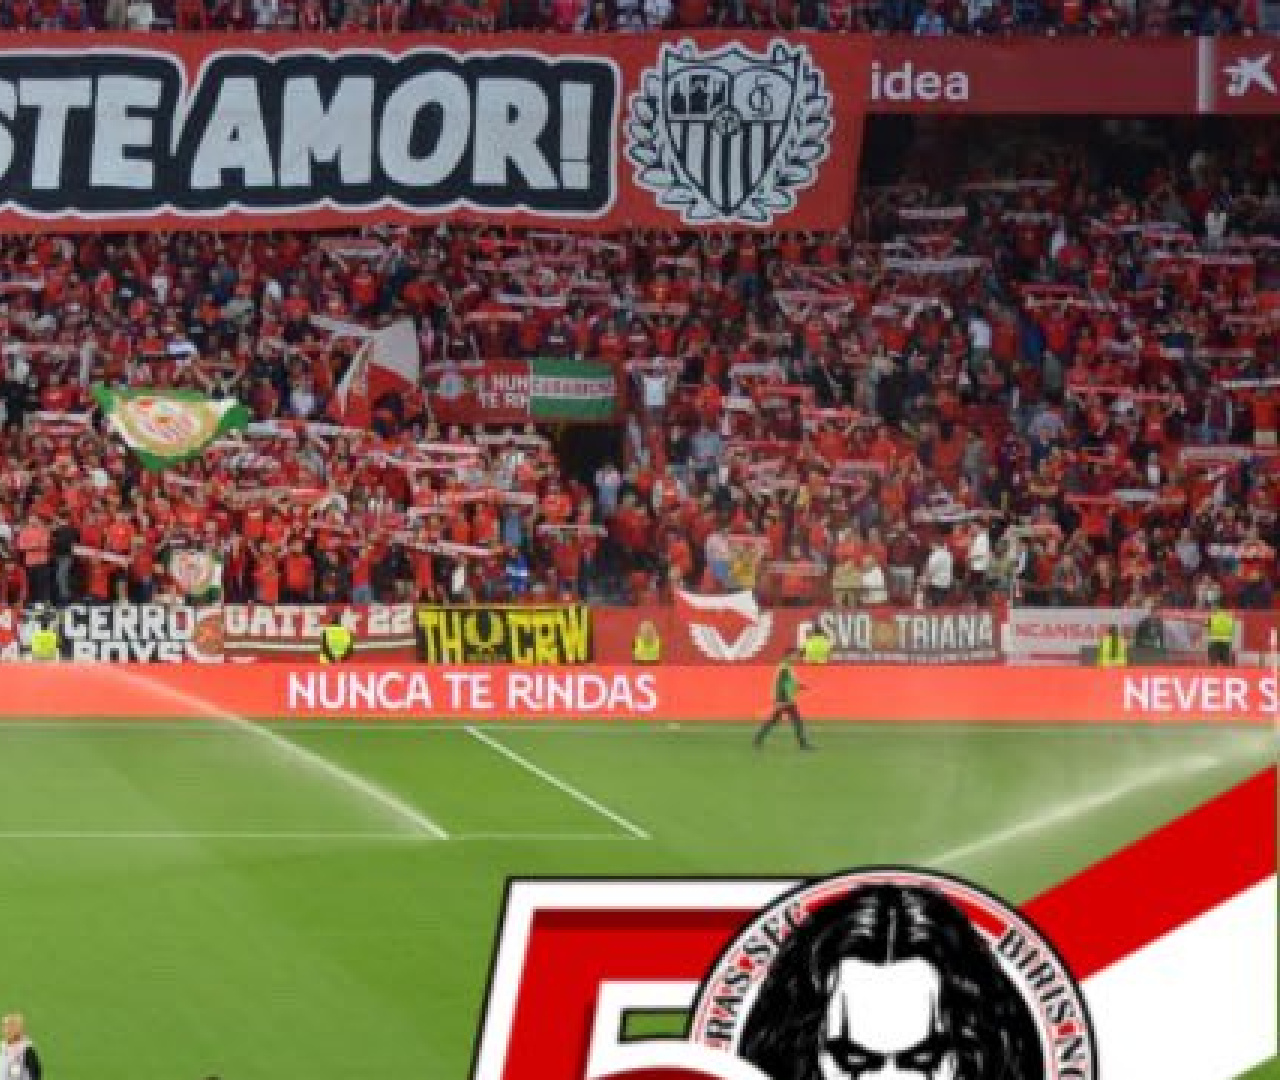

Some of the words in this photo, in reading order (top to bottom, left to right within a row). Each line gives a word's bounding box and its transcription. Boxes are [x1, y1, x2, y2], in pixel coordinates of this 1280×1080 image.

[871, 62, 969, 100] idea
[188, 71, 593, 191] AMOR!
[64, 606, 193, 638] CERRO
[367, 605, 413, 634] 22
[896, 614, 994, 648] TRIANA
[289, 672, 432, 709] NUNCA
[444, 672, 493, 709] TE
[508, 673, 657, 711] RINDAS
[1123, 677, 1248, 712] NEVER
